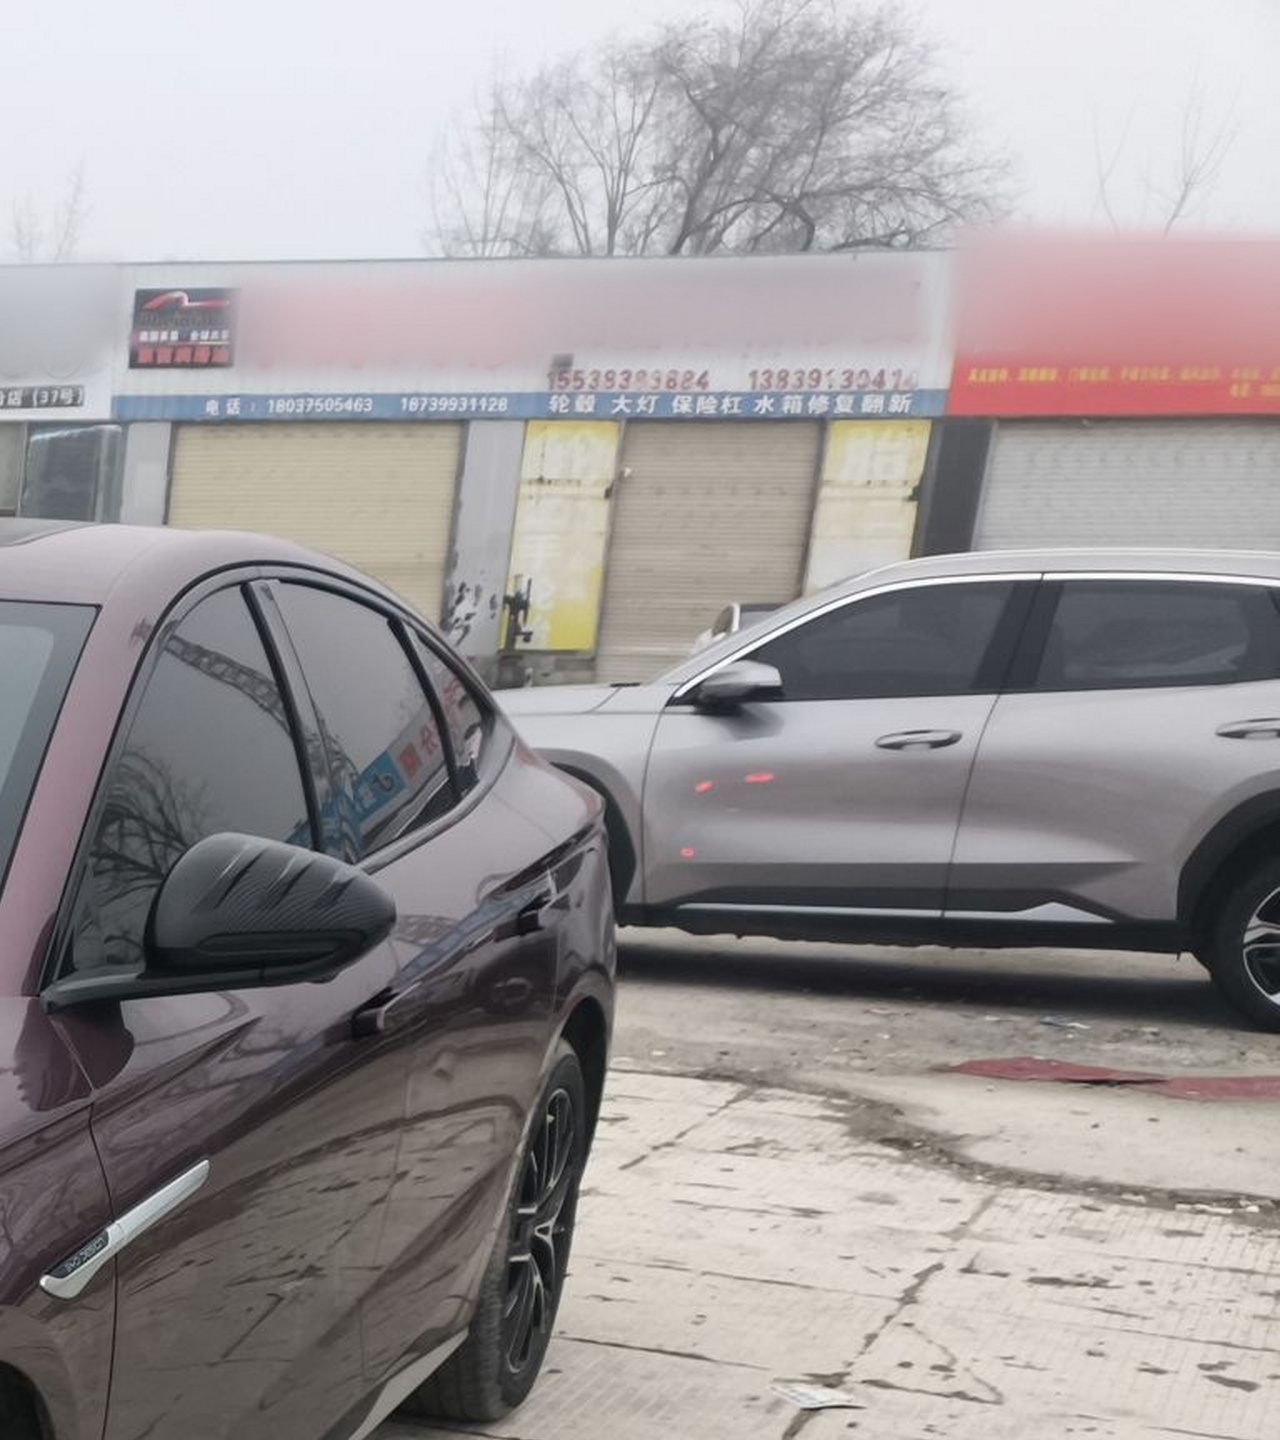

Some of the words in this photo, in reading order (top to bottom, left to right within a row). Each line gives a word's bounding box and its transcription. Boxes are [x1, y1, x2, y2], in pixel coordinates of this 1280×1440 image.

[611, 395, 660, 414] 大灯
[671, 395, 743, 414] 保险杠
